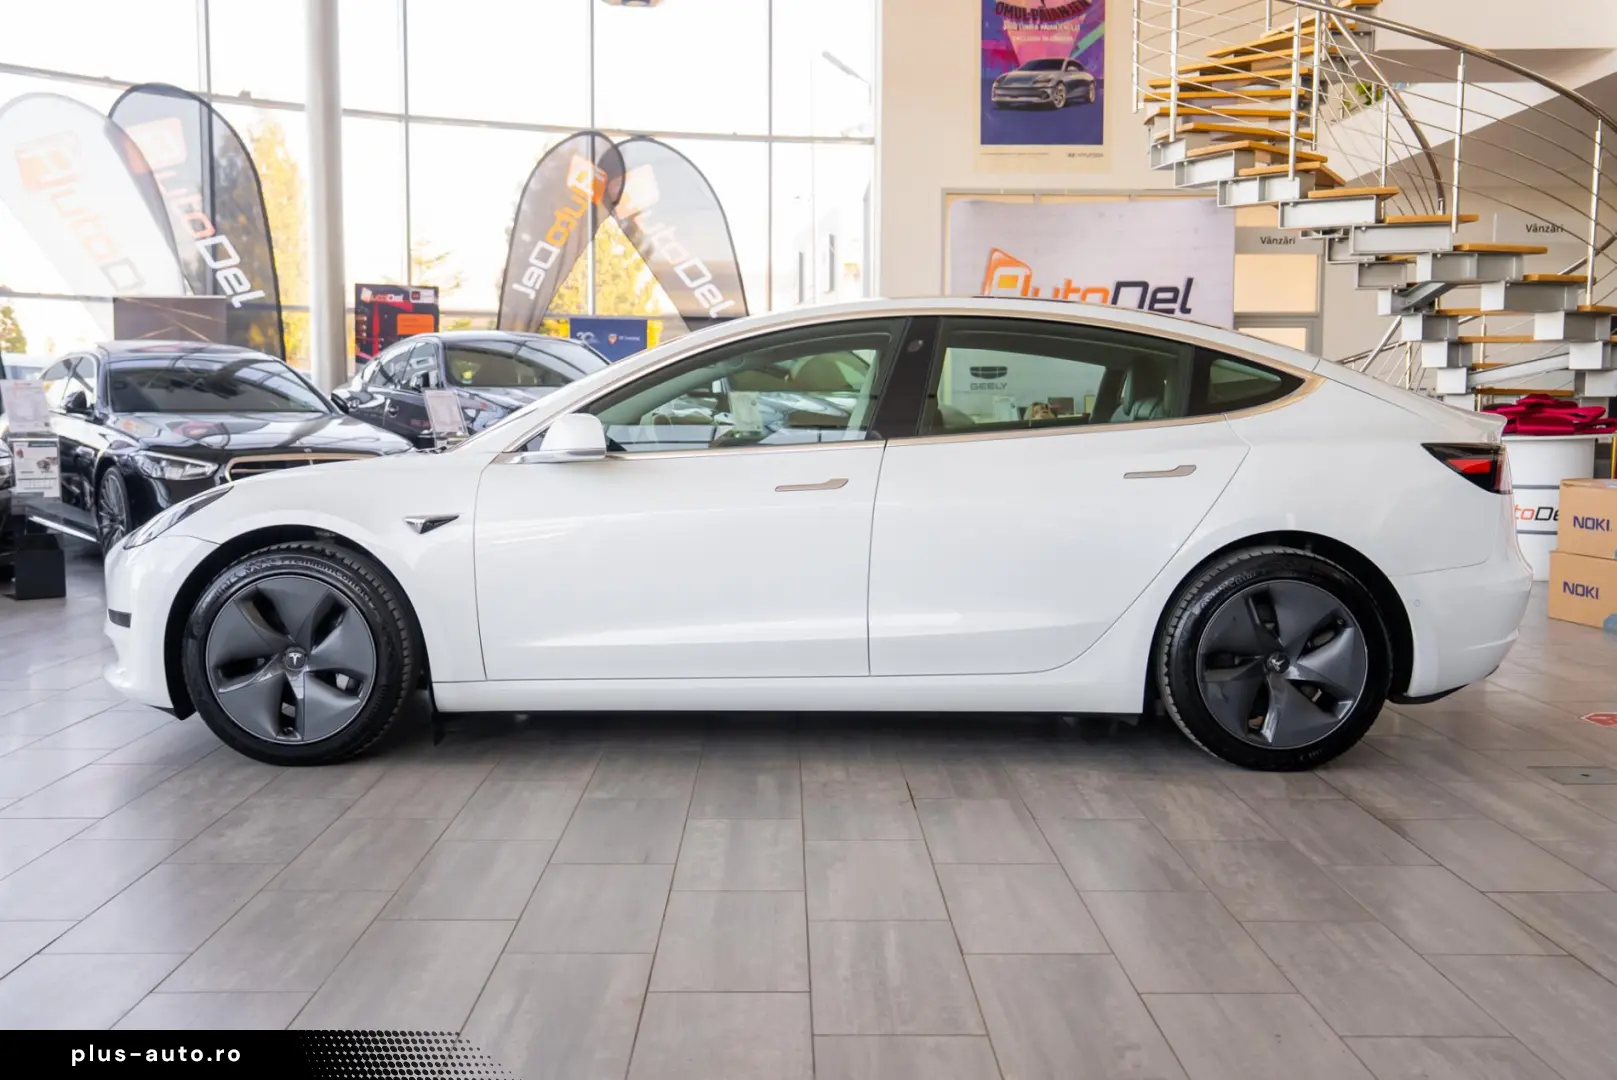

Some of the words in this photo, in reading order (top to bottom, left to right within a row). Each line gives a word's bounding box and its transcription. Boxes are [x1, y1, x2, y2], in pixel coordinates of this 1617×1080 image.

[122, 117, 265, 308] utoDel
[613, 164, 736, 319] utoDel
[970, 382, 1008, 391] GEELY
[1562, 581, 1600, 600] NOKI
